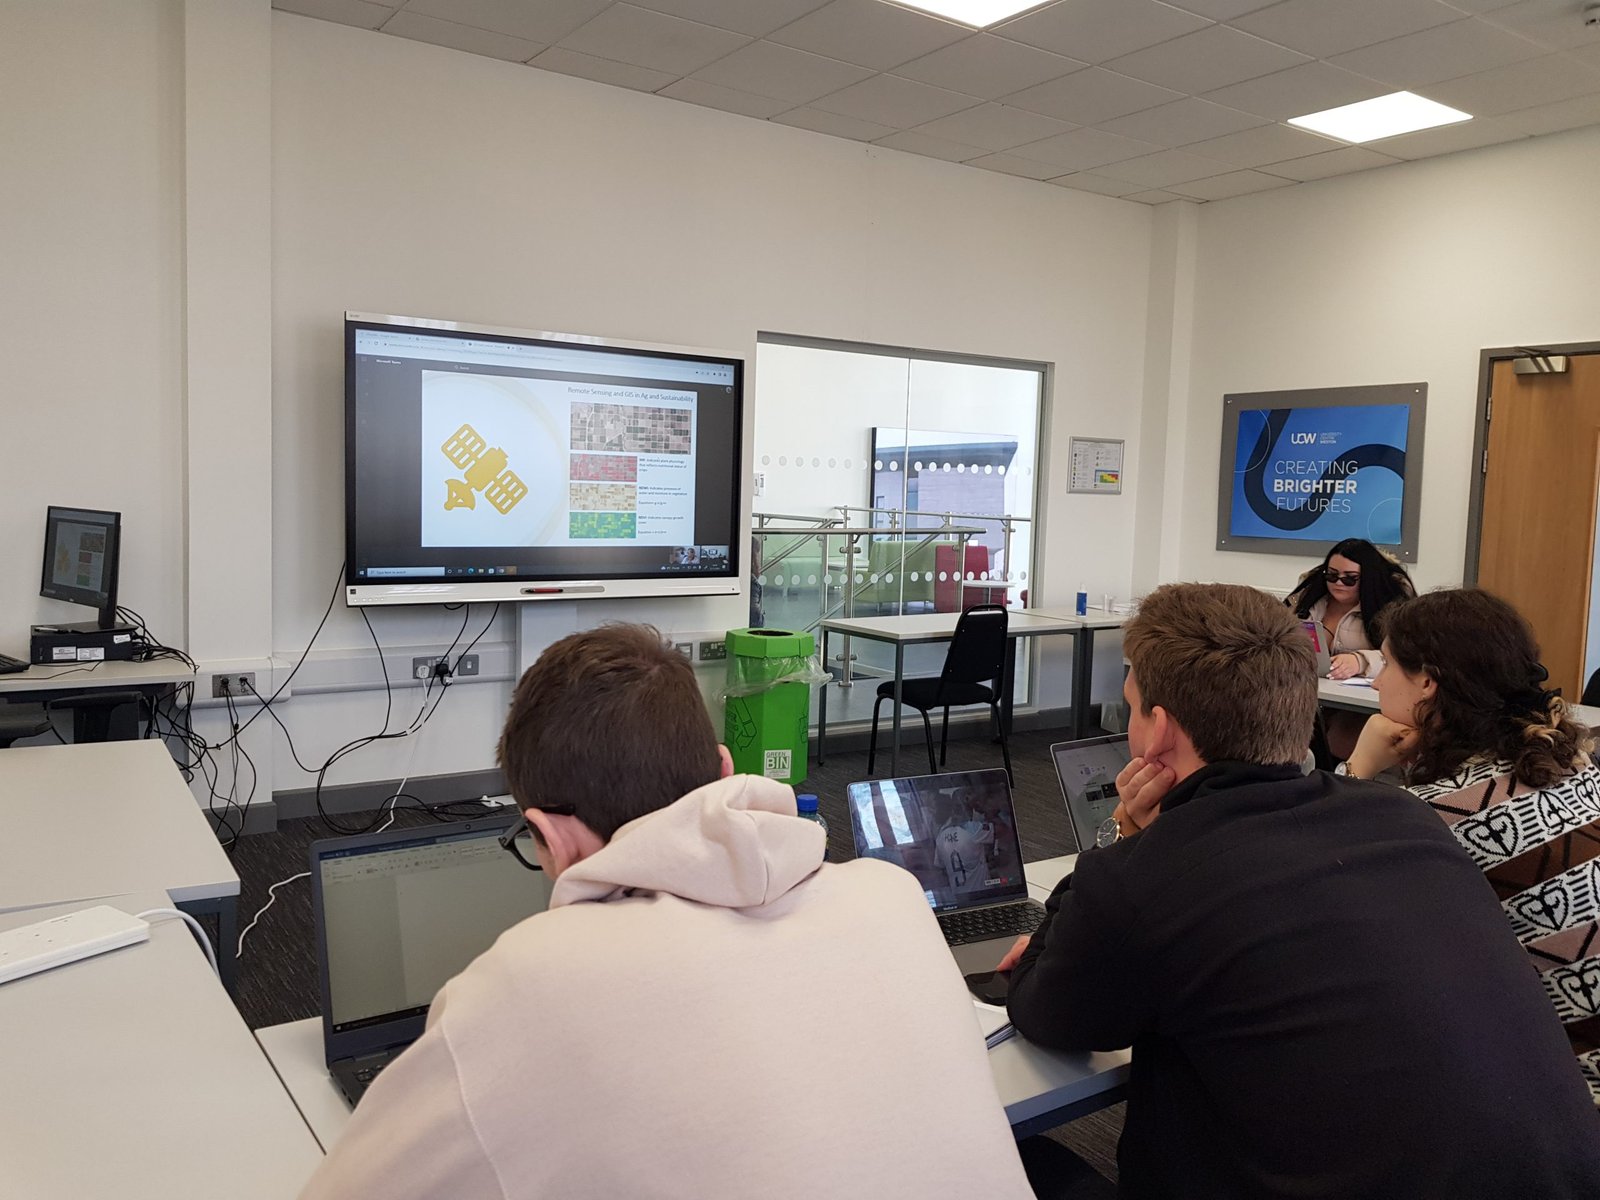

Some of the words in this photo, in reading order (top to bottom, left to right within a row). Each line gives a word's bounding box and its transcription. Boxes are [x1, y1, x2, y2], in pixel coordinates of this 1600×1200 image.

[613, 389, 624, 397] and
[624, 390, 634, 398] GIS
[649, 392, 660, 400] and
[1291, 432, 1317, 445] UCW
[1274, 460, 1358, 475] CREATING
[1273, 479, 1358, 494] BRIGHTER
[1276, 497, 1351, 514] FUTURES
[766, 757, 789, 769] BIN
